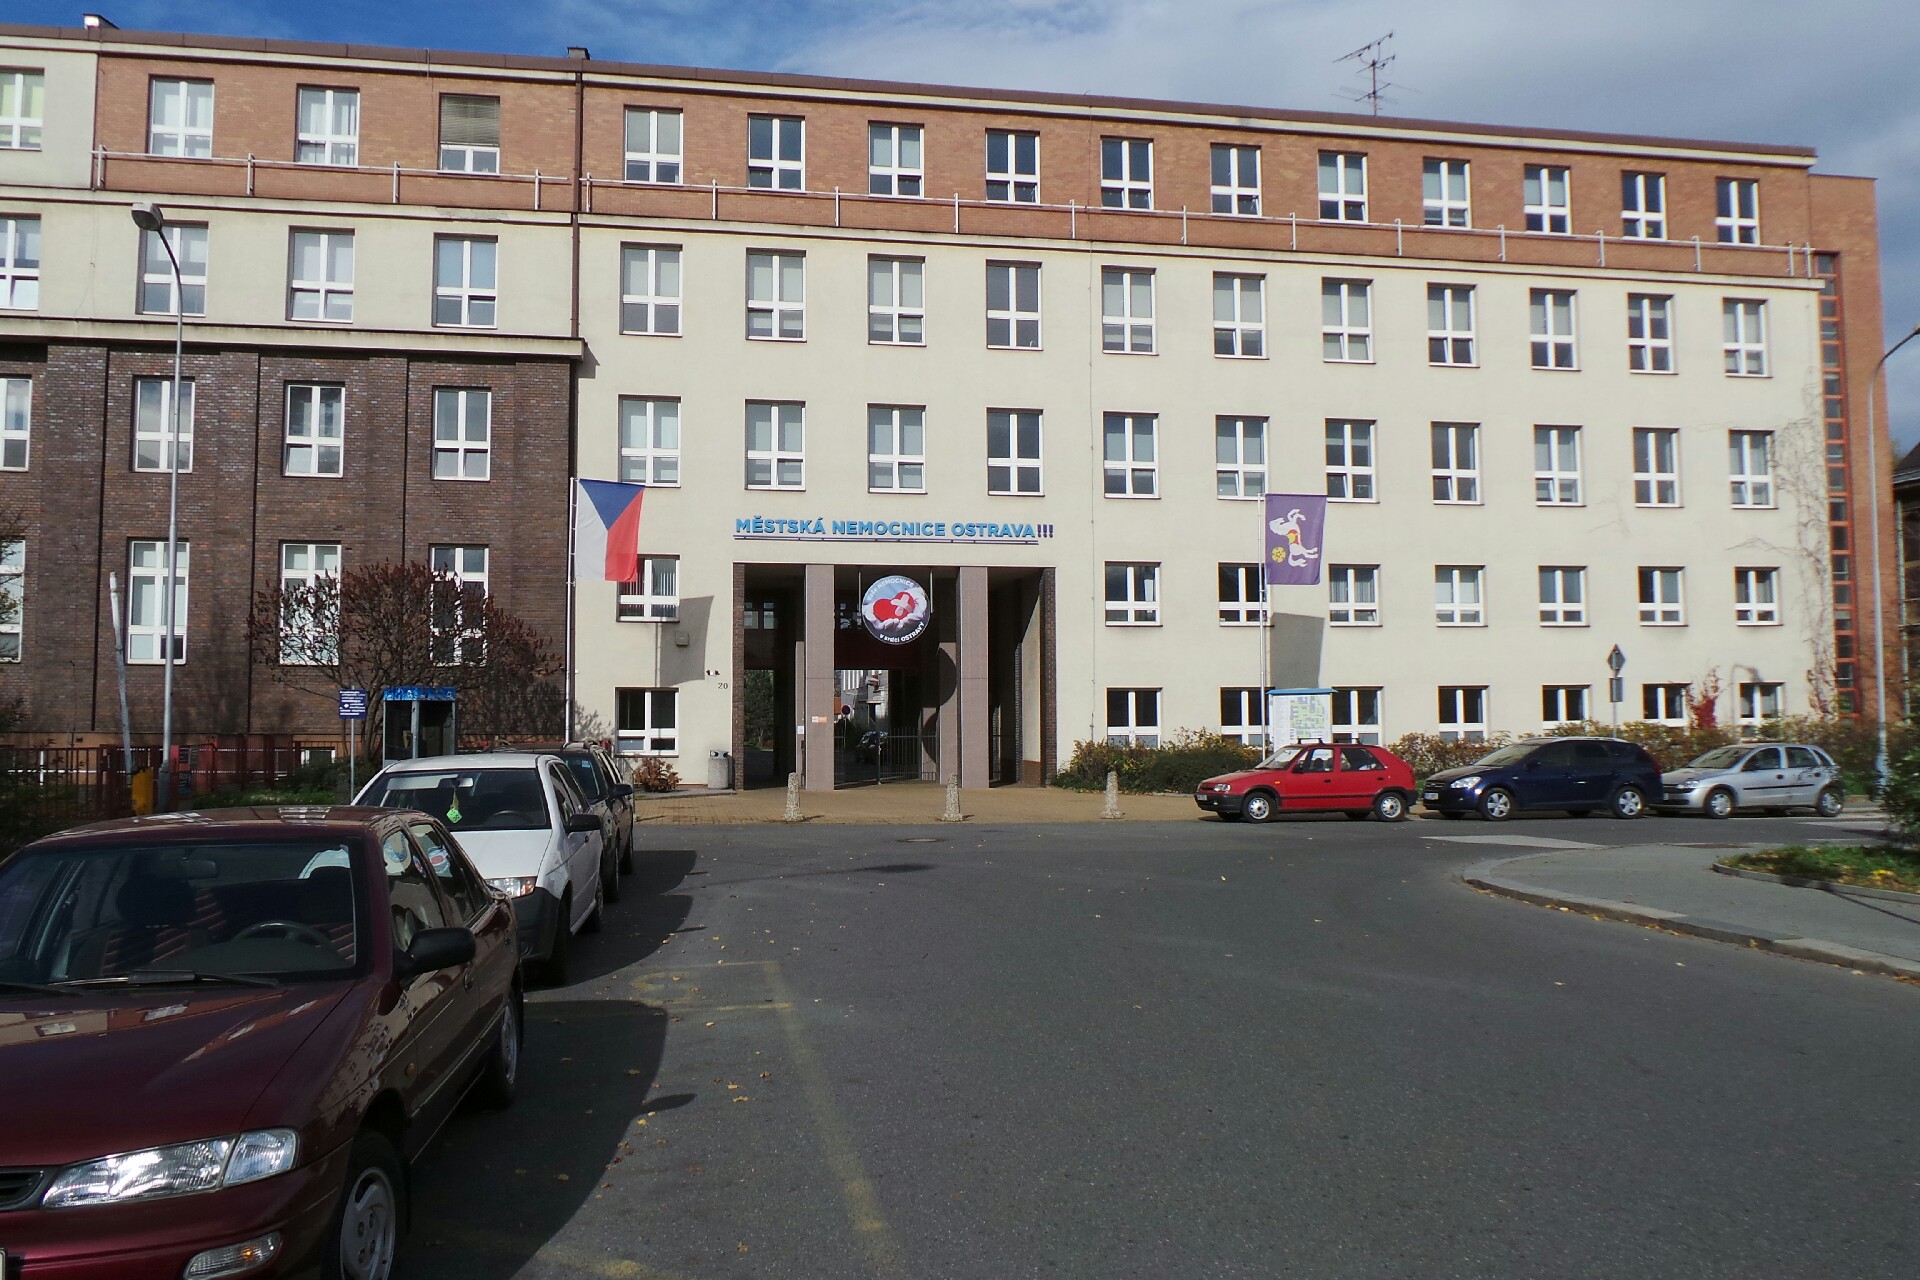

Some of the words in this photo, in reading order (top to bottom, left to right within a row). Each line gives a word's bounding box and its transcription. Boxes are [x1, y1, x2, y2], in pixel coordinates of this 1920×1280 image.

[735, 515, 826, 535] MĚSTSKÁ
[832, 520, 946, 537] NEMOCNICE
[877, 577, 914, 588] NEMOCNICE
[900, 621, 925, 642] OSTRAVY
[717, 682, 729, 690] 20
